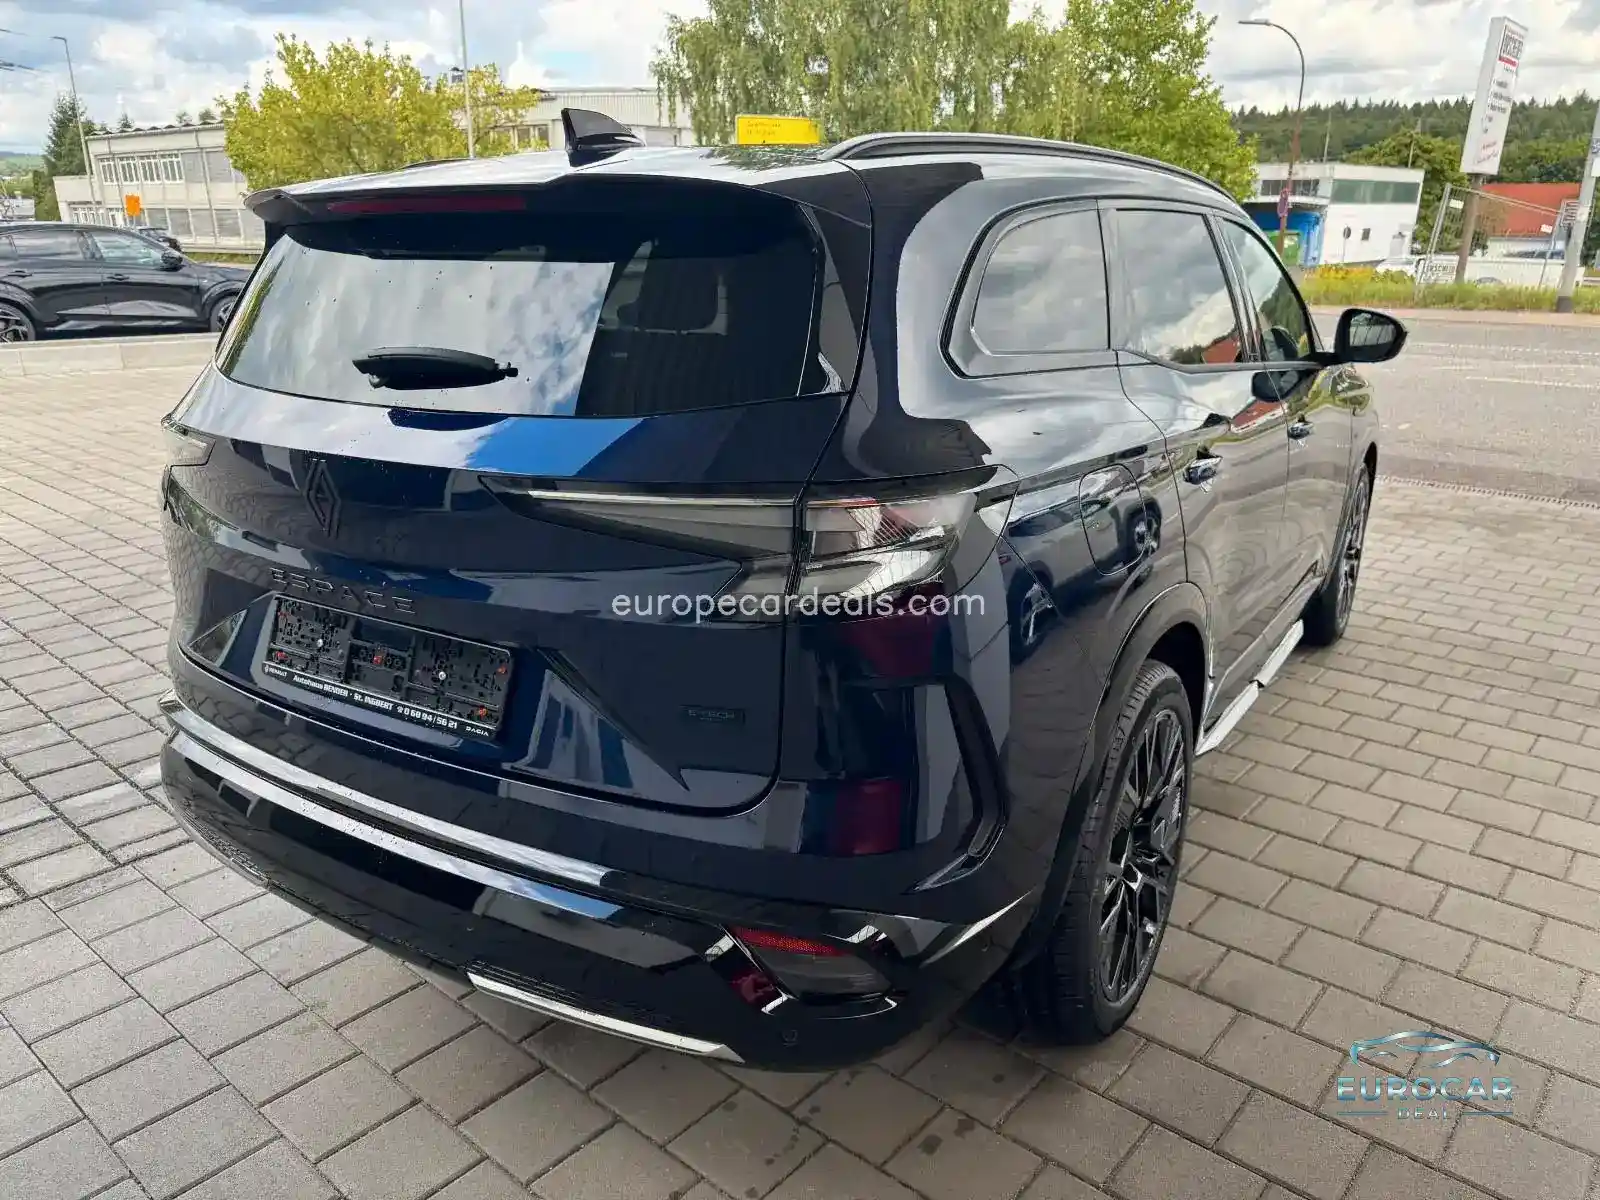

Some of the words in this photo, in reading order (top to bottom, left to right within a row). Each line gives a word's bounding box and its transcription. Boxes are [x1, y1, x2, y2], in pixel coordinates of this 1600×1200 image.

[269, 567, 417, 614] ESPACE
[269, 667, 287, 677] RENAULT
[293, 675, 323, 689] Autohaus
[323, 684, 349, 697] BENDER
[353, 693, 364, 702] St.
[364, 696, 393, 709] INGBERT
[465, 726, 488, 736] DACIA
